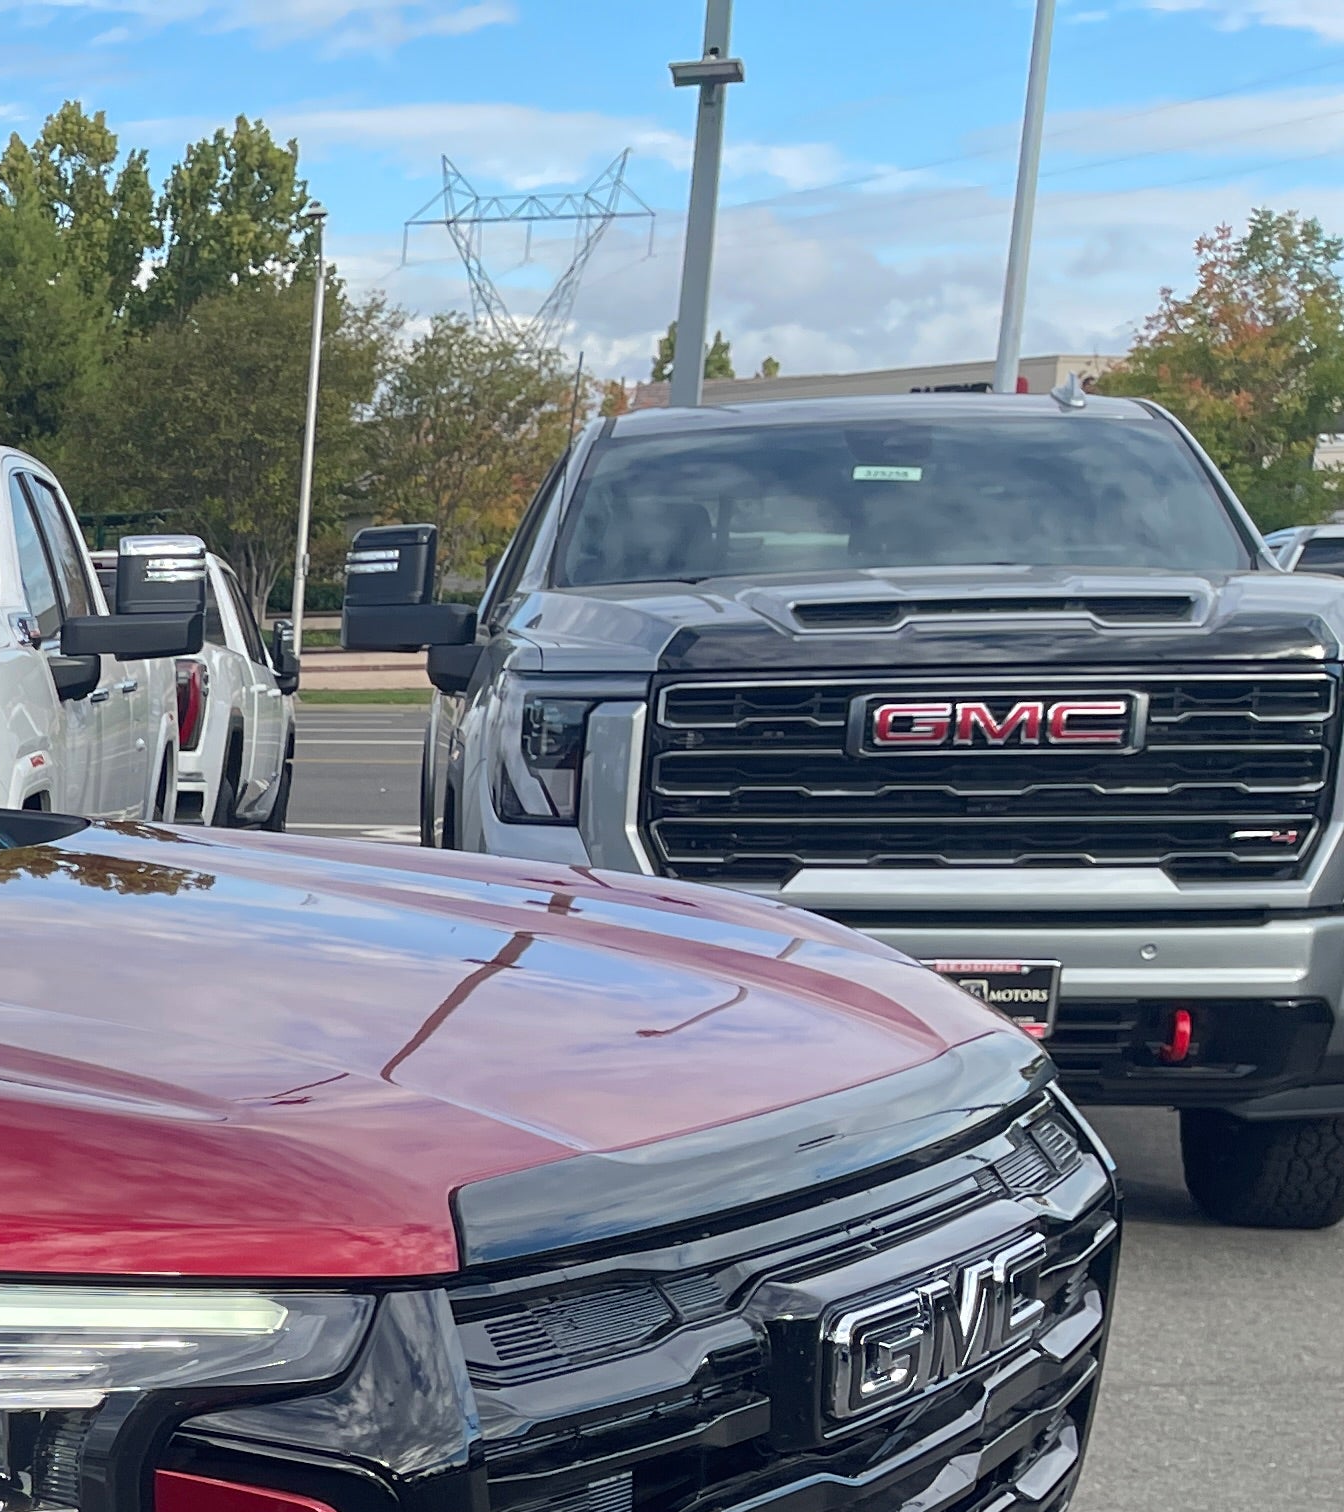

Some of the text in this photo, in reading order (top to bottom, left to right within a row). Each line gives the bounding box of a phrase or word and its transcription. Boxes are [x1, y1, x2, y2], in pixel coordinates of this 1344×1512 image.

[872, 701, 1127, 747] GMC
[988, 988, 1049, 1003] MOTORS
[824, 1231, 1047, 1419] GMC
